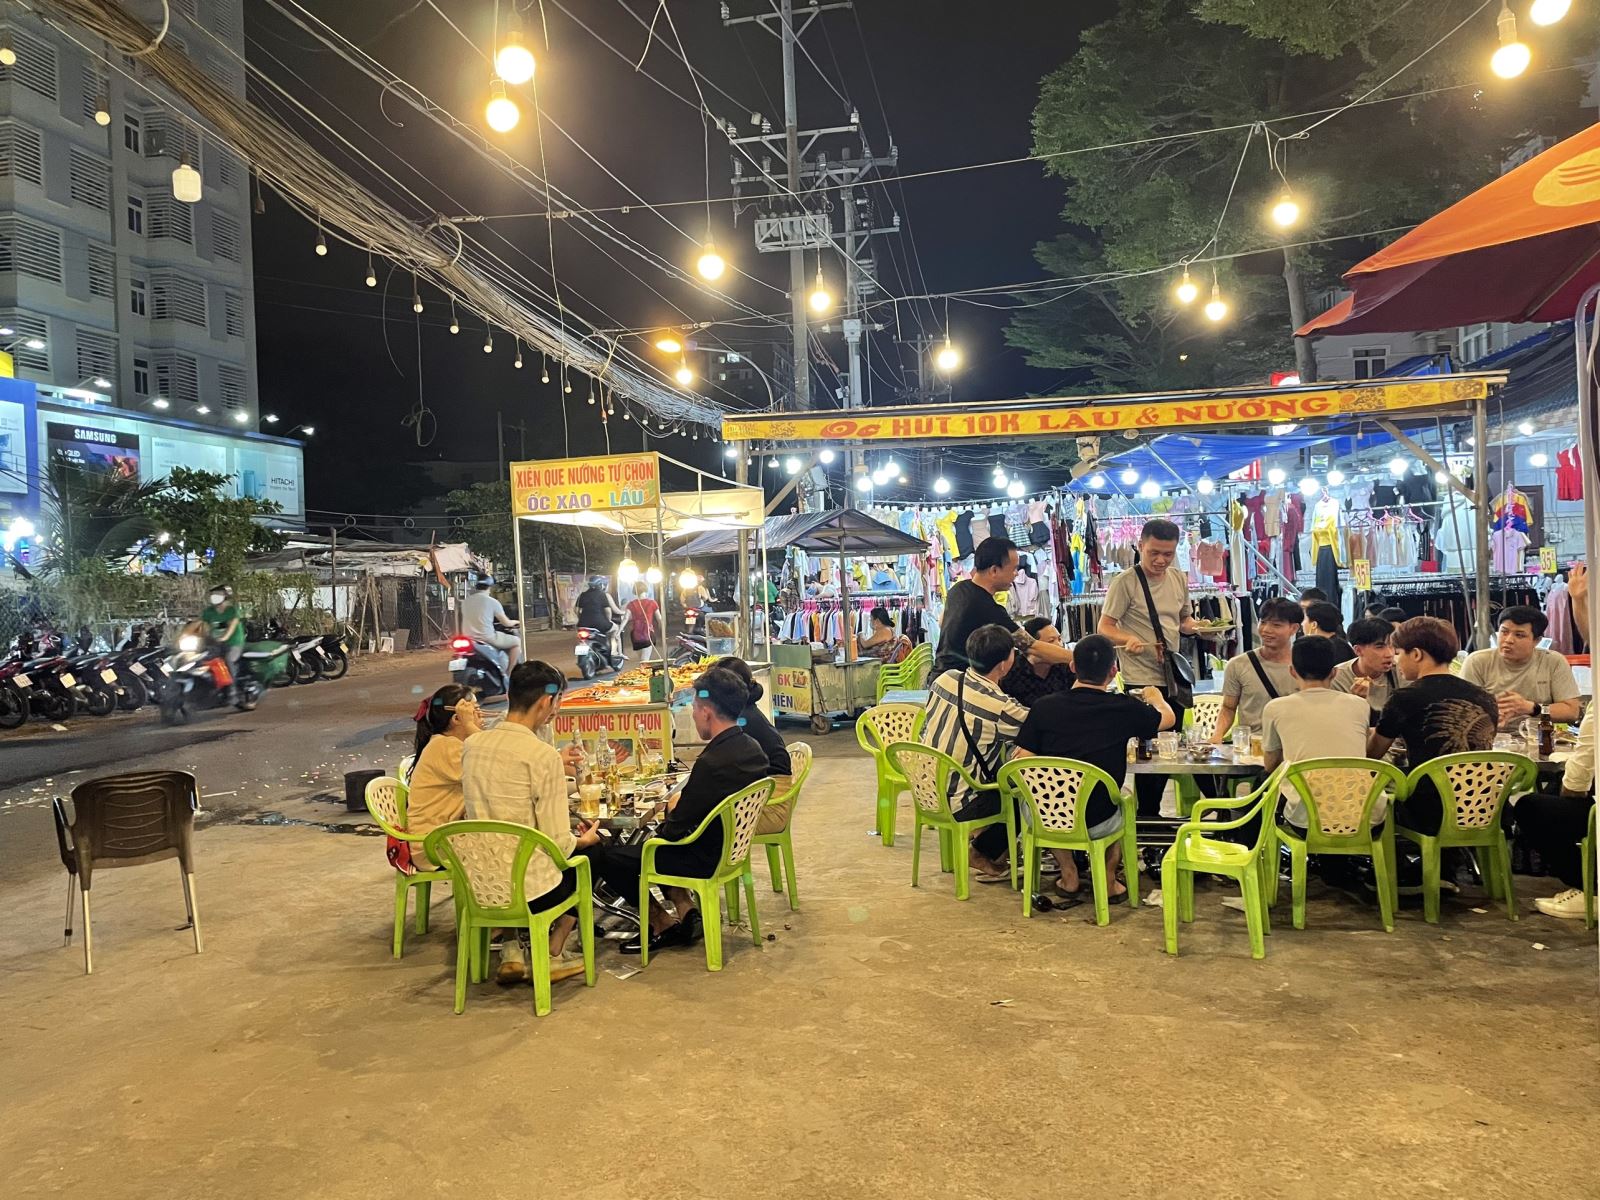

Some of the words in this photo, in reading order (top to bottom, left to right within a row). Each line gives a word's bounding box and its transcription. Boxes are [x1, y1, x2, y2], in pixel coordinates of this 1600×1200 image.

[963, 413, 1020, 435] 10K
[1135, 406, 1160, 426] &
[74, 428, 117, 444] SAMSUNG
[271, 476, 295, 487] HITACHI
[544, 467, 565, 489] QUE
[567, 462, 605, 486] NƯỚNG
[527, 491, 551, 511] ỐC
[556, 490, 592, 510] XÀO
[777, 673, 791, 687] 6K
[618, 712, 631, 735] TỰ
